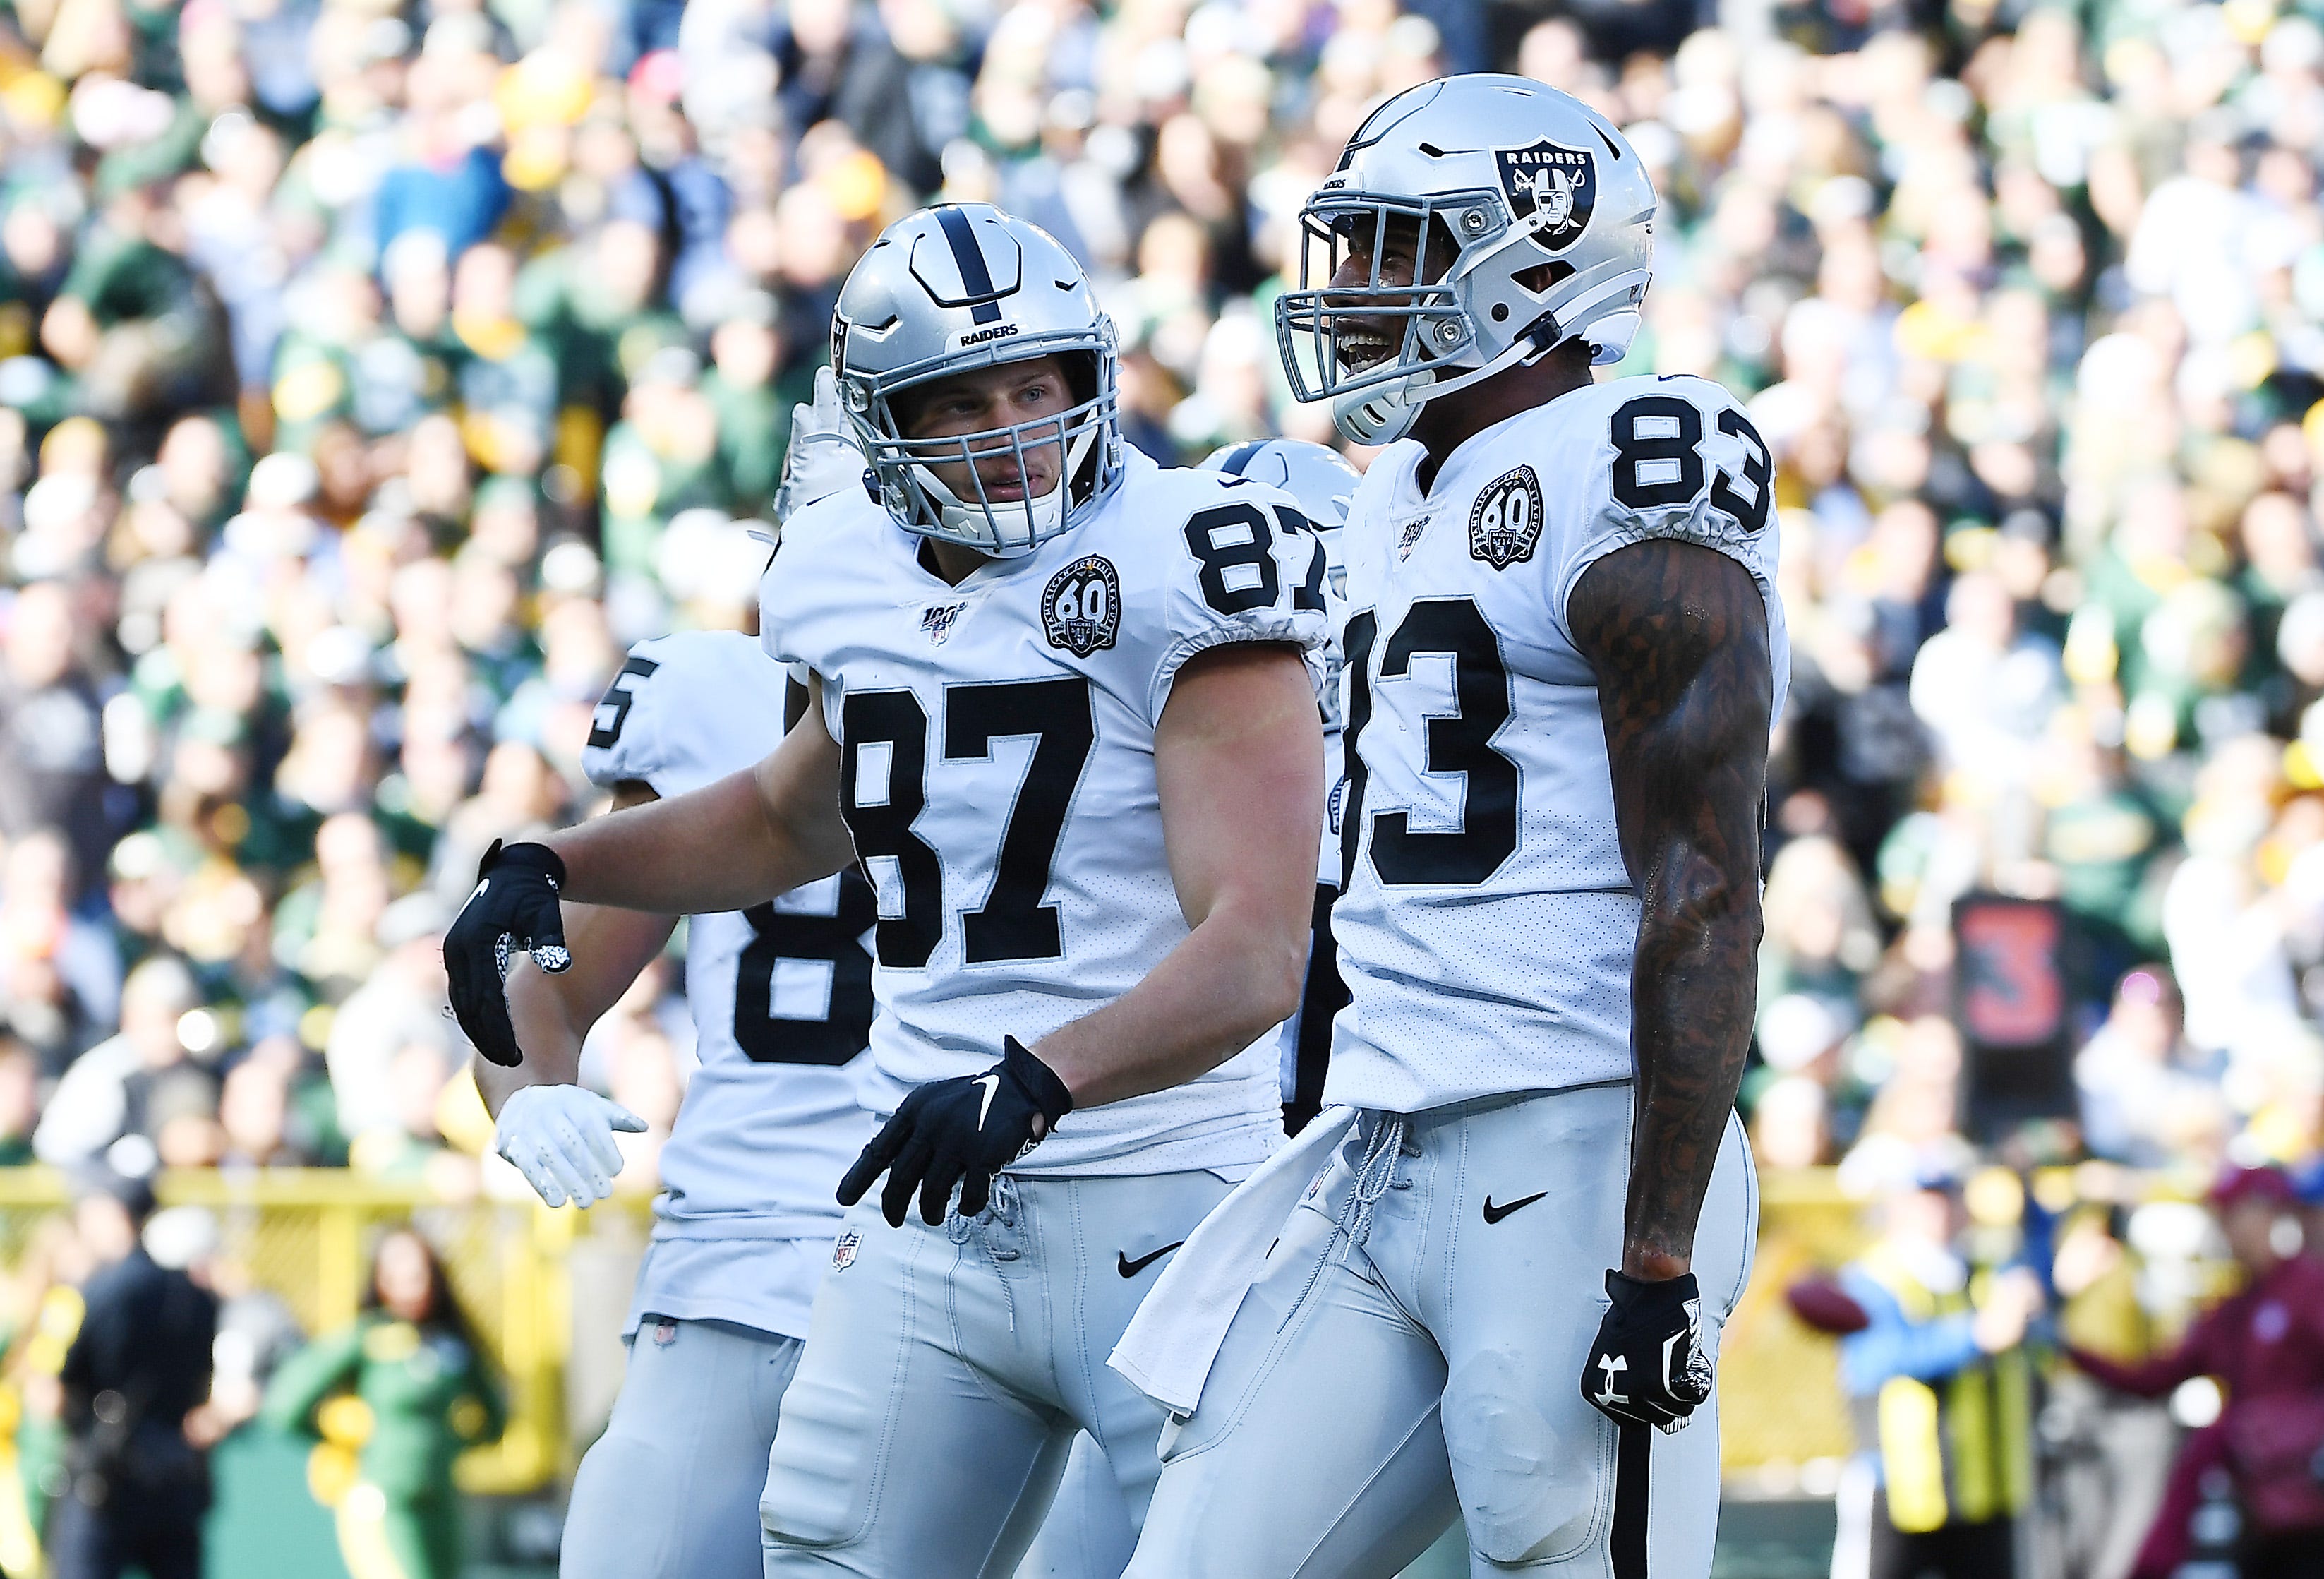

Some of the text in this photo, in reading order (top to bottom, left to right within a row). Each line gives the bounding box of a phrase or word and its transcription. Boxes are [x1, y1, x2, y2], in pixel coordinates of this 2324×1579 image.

[1323, 179, 1347, 190] IDERS
[1506, 151, 1587, 166] RAIDERS
[960, 323, 1018, 347] RAIDERS
[1611, 395, 1772, 534] 83
[1480, 487, 1529, 534] 60
[1044, 559, 1116, 626] AMERICAN FOOTBALL LEAGUE
[1183, 503, 1327, 616] 87
[1054, 578, 1107, 624] 60
[586, 656, 661, 750] 5
[840, 675, 1097, 970] 87
[733, 863, 877, 1067] 8
[1961, 904, 2062, 1045] 3
